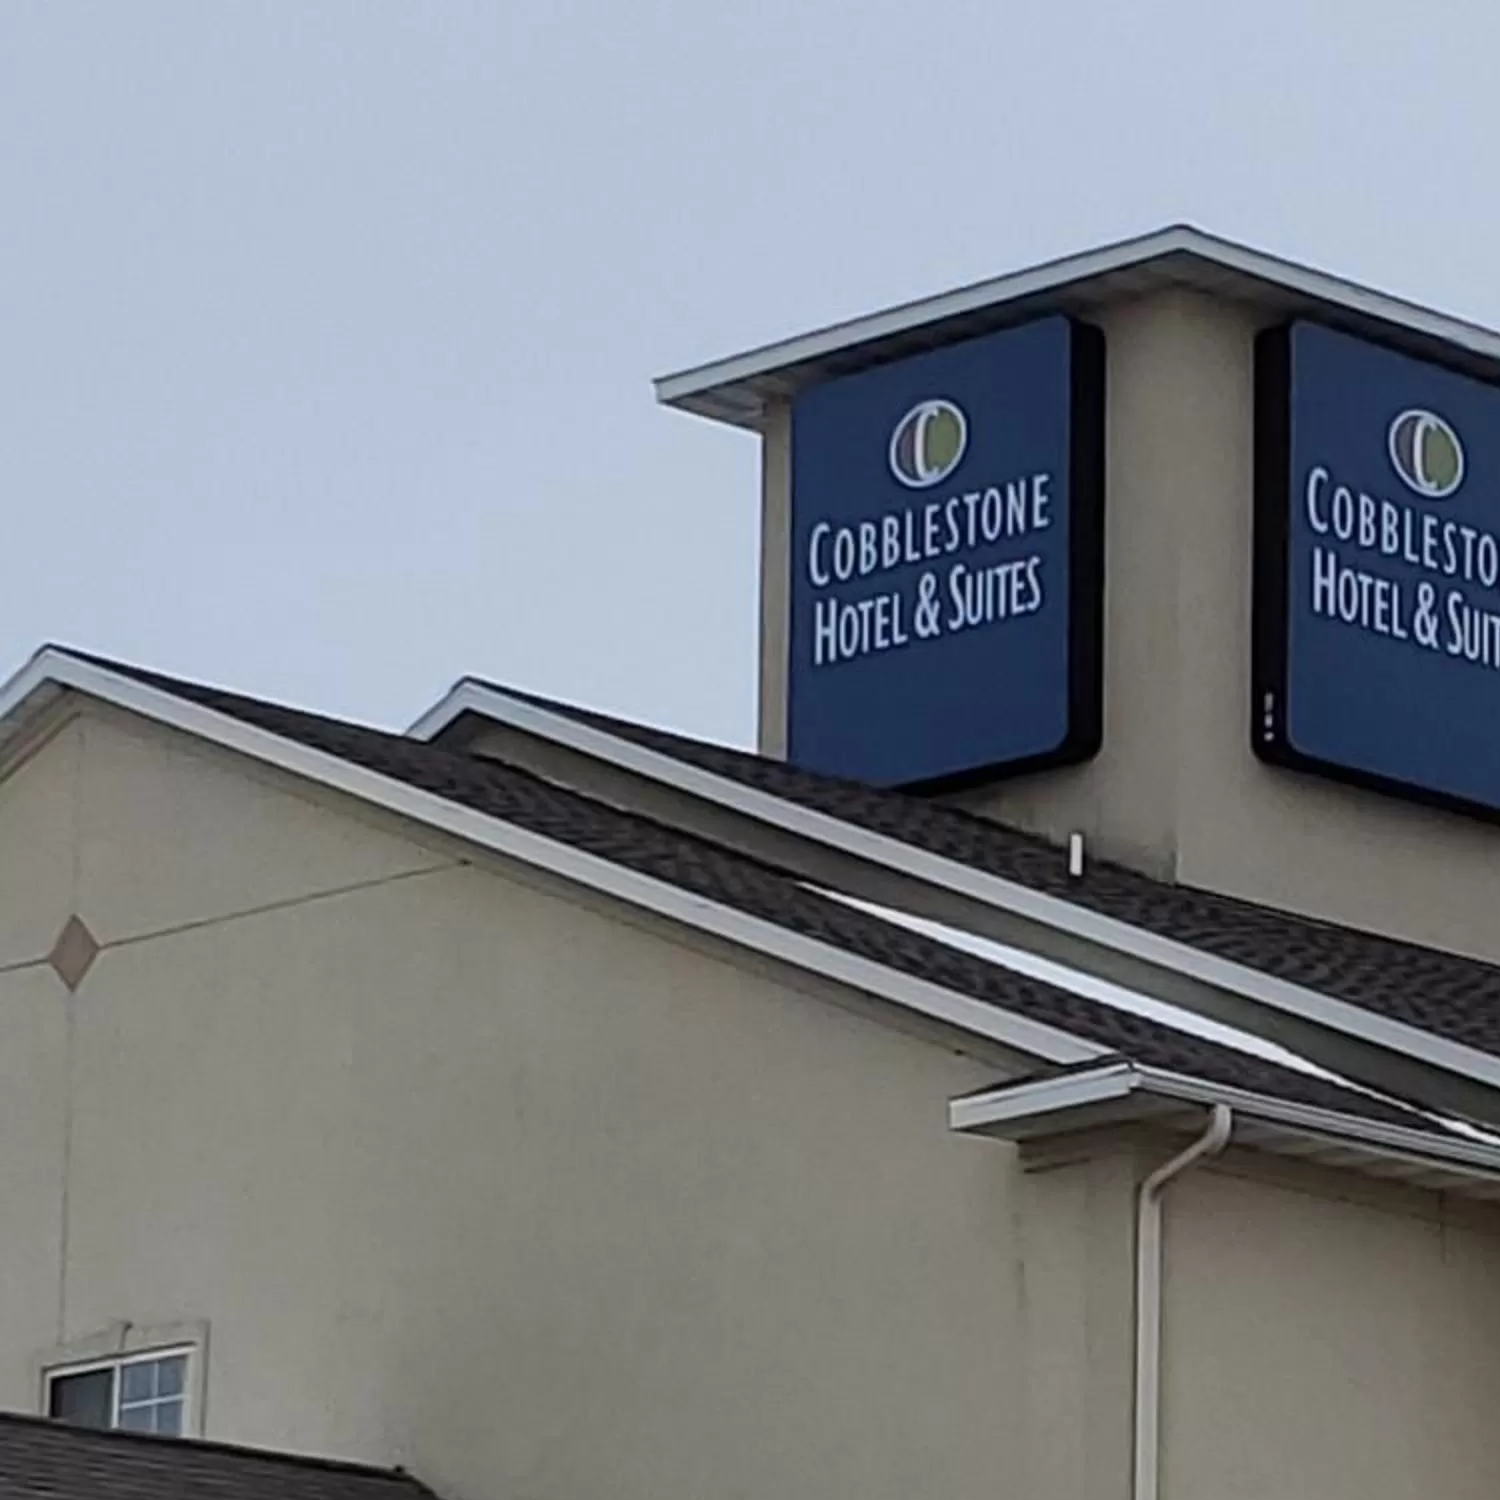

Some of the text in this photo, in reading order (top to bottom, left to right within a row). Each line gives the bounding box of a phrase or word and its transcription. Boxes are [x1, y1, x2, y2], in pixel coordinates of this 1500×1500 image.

[809, 474, 1050, 586] COBBLESTONE
[814, 556, 1042, 665] HOTEL & SUITES
[1312, 548, 1408, 640] HOTEL
[1413, 583, 1440, 649] &
